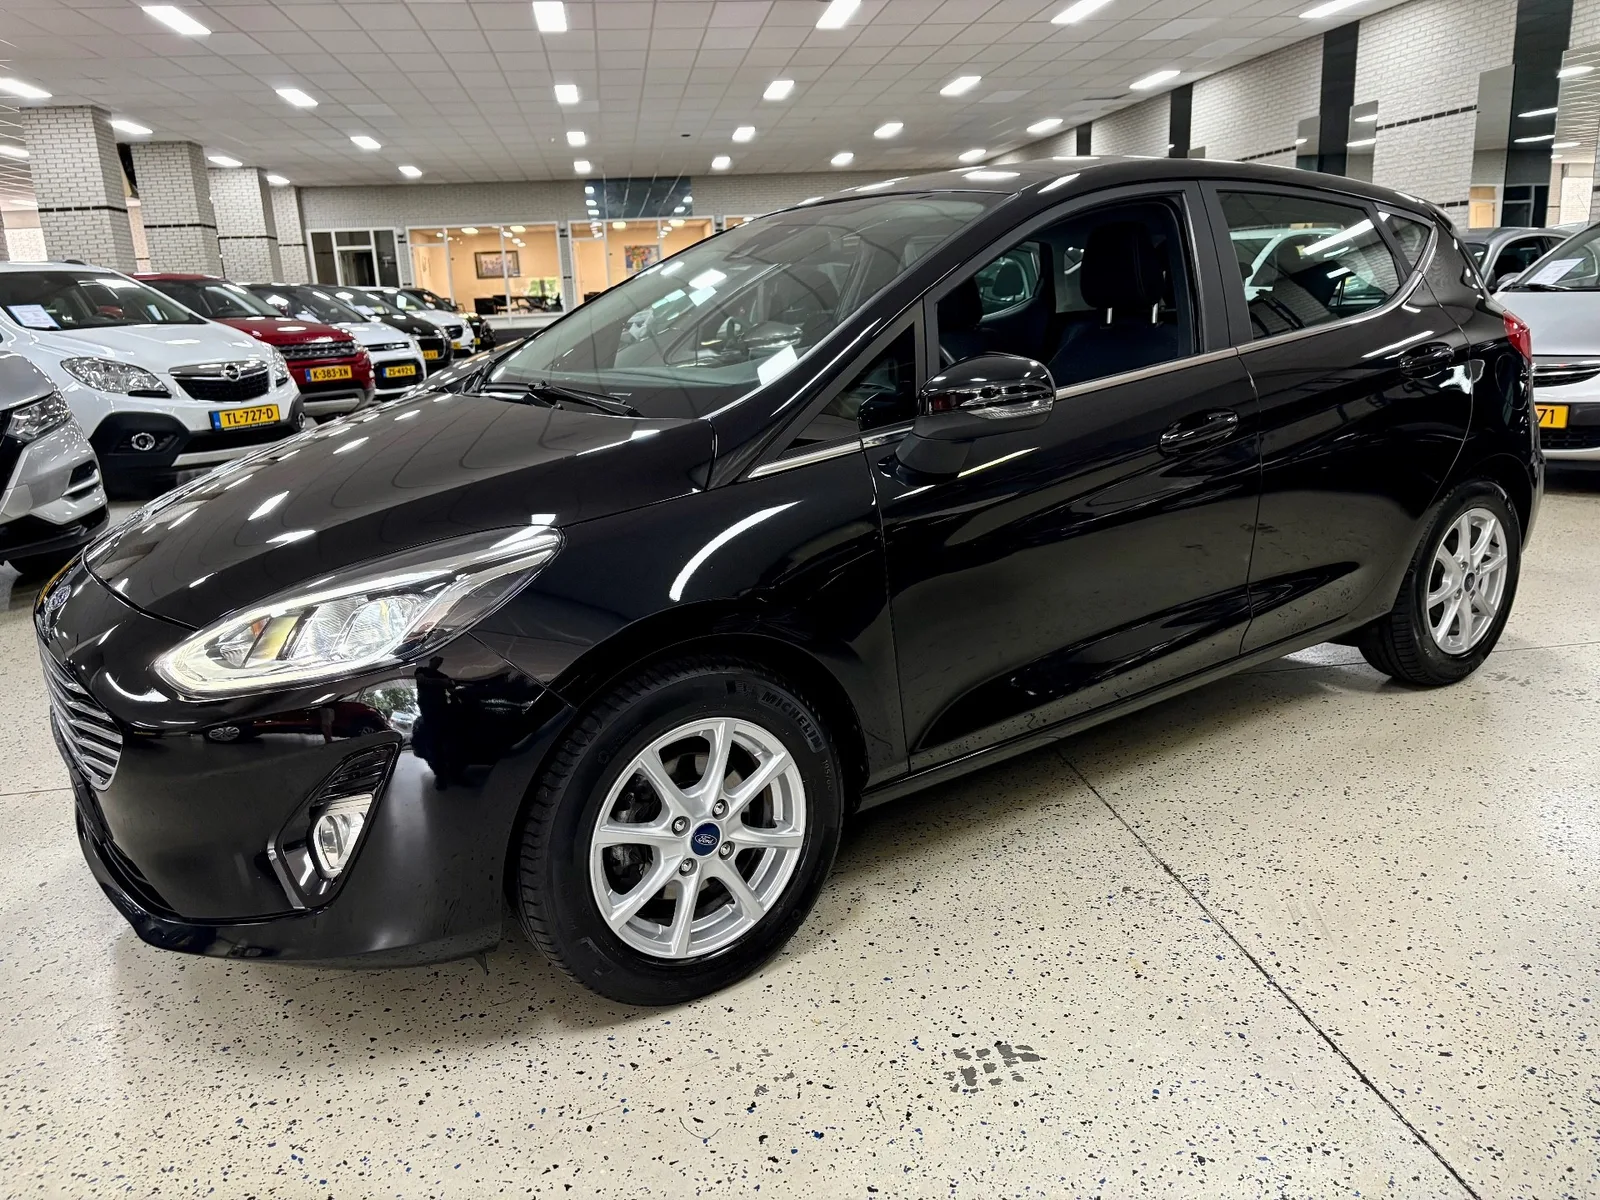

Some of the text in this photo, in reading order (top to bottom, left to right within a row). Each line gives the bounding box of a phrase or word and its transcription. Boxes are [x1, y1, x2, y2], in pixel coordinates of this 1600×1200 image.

[313, 367, 349, 379] K-383-XN
[224, 408, 274, 425] TL-727-D
[1537, 408, 1555, 425] 71
[761, 691, 823, 749] MICHELIN
